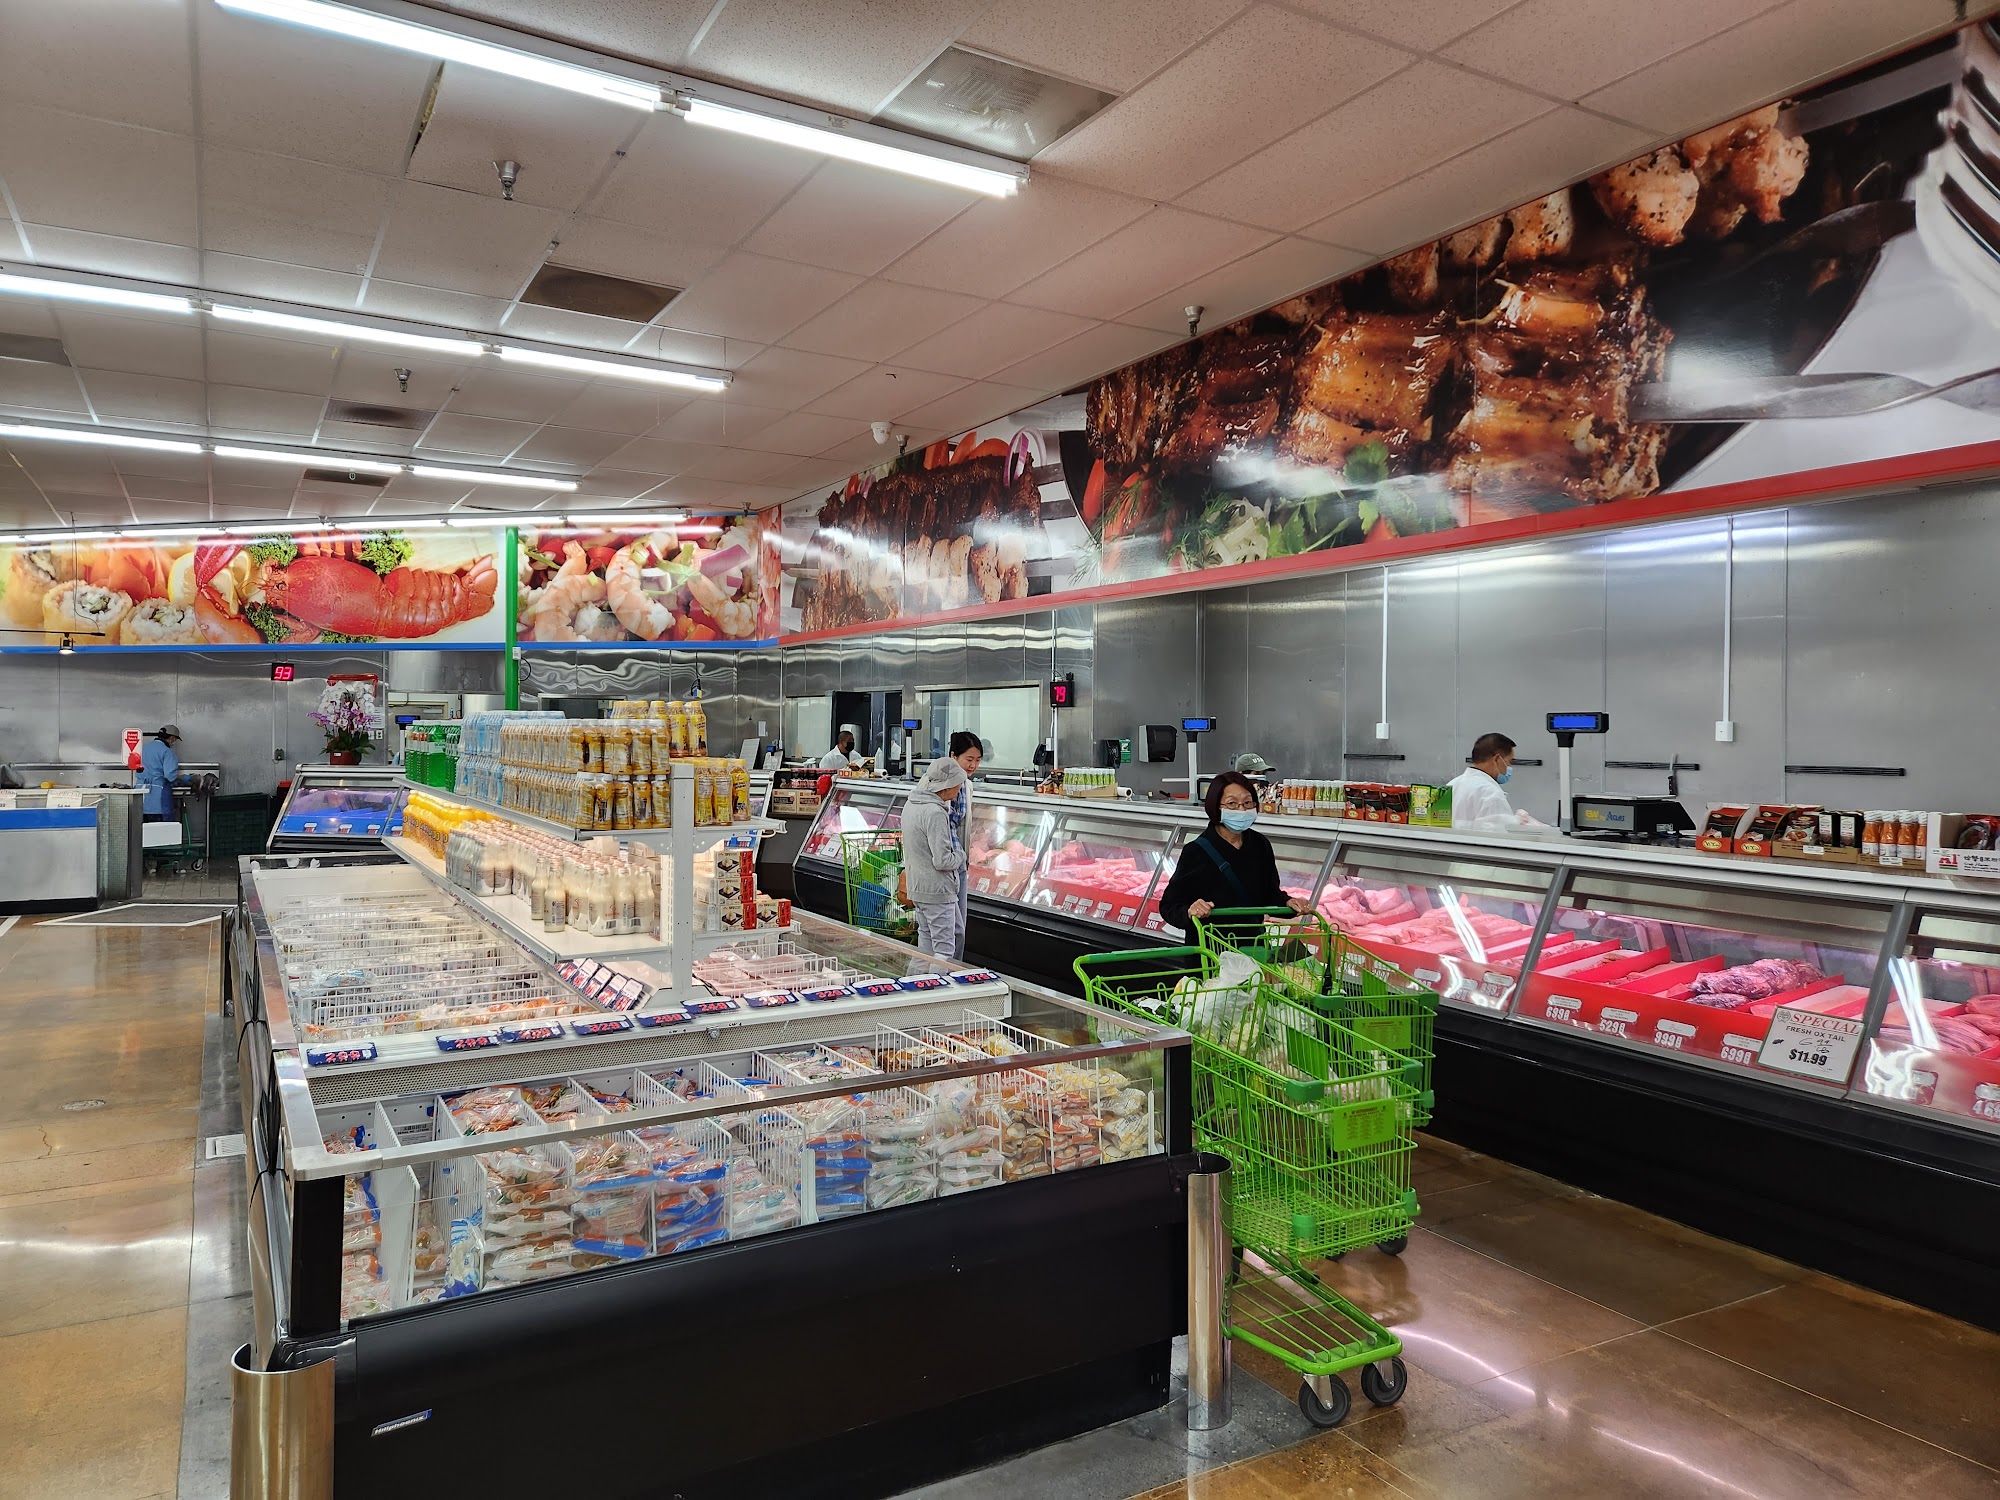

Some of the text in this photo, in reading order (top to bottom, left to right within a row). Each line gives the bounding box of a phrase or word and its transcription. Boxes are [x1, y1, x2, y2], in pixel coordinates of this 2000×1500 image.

[274, 666, 292, 680] 93
[1790, 1014, 1860, 1035] SPECIAL
[1786, 1026, 1812, 1035] FRESH
[1828, 1033, 1846, 1042] TAIL
[1789, 1048, 1828, 1066] $11.99
